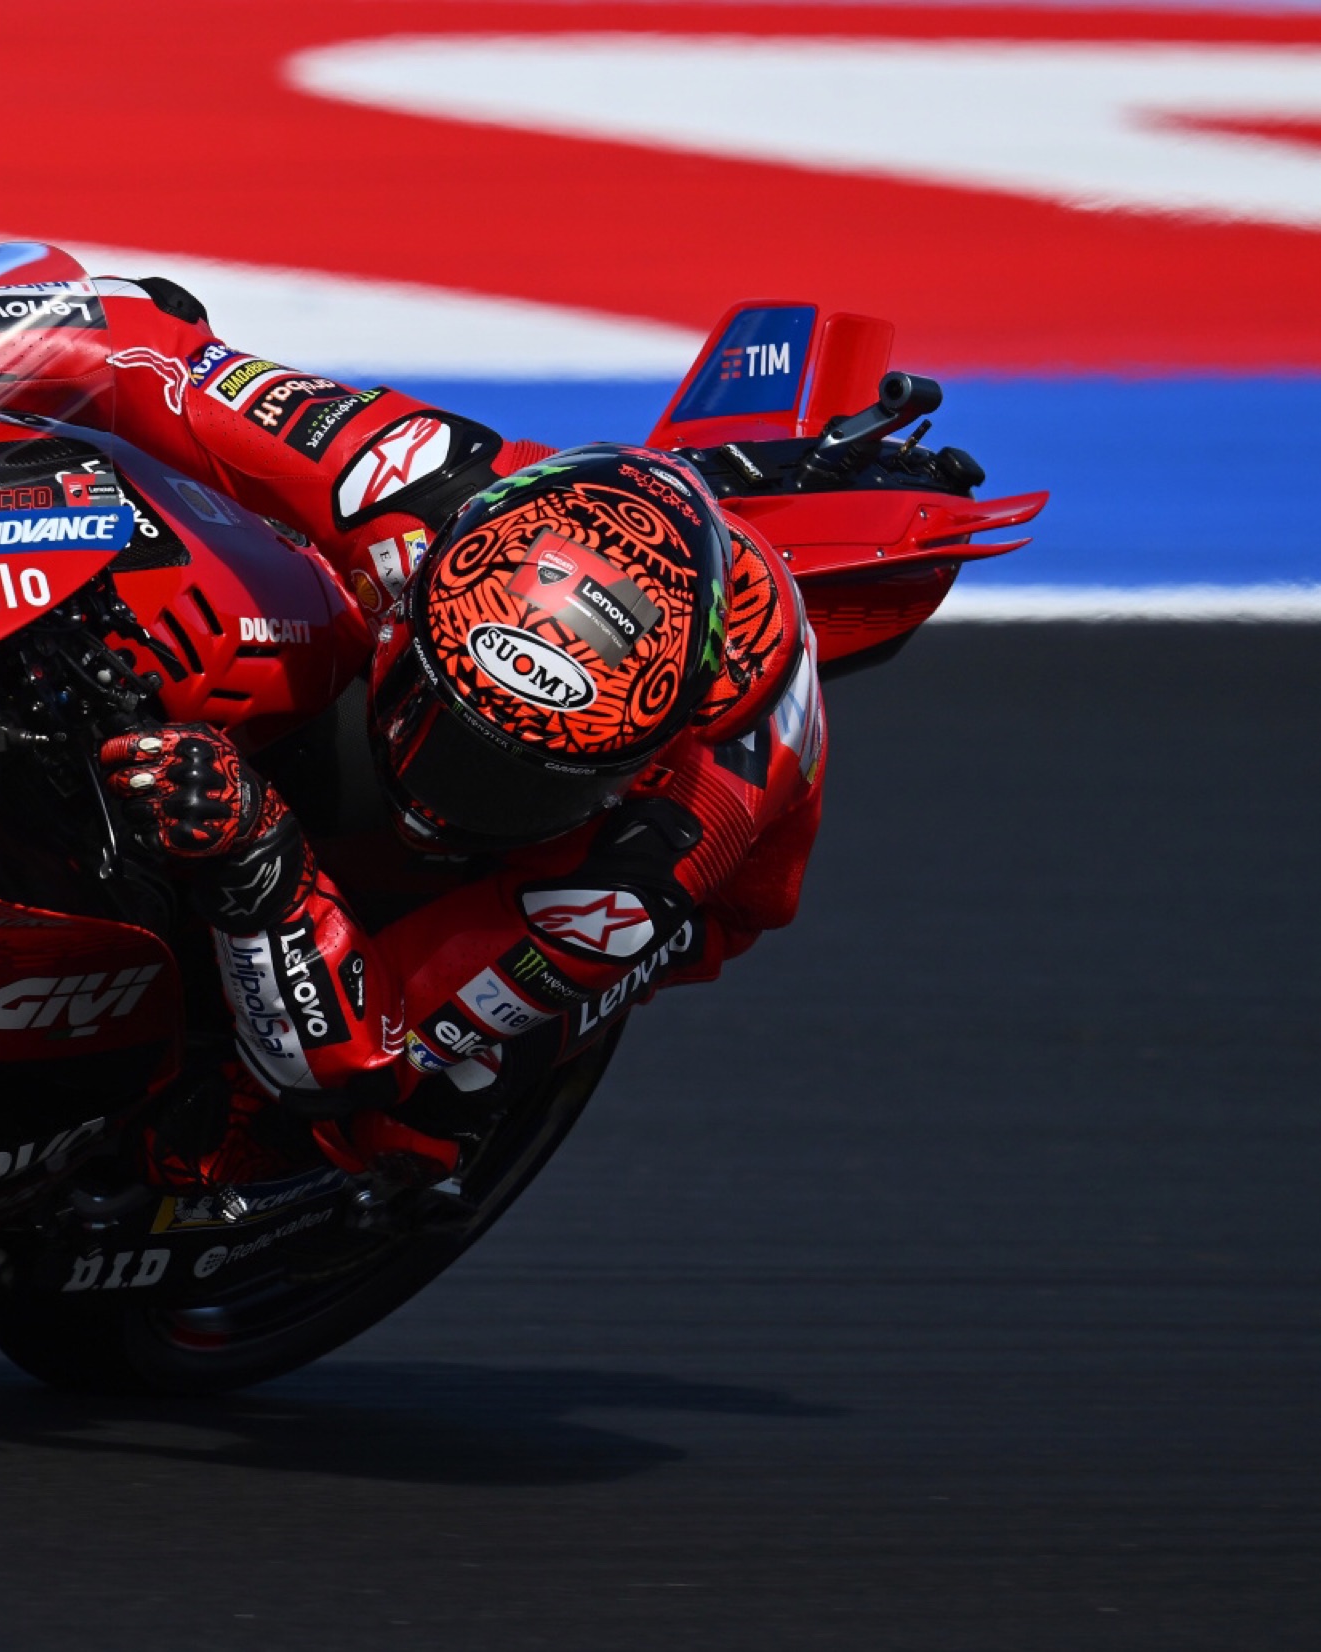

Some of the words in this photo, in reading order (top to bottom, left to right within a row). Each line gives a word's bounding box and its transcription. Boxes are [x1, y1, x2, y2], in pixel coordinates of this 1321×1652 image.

[746, 342, 791, 377] TIM
[253, 378, 336, 427] aruba.it
[306, 397, 359, 449] MONSTER
[239, 617, 311, 643] DUCATI
[582, 582, 635, 635] Lenovo
[412, 637, 439, 686] CARRERA
[480, 628, 581, 707] SUOMY
[280, 927, 328, 1038] Lenovo
